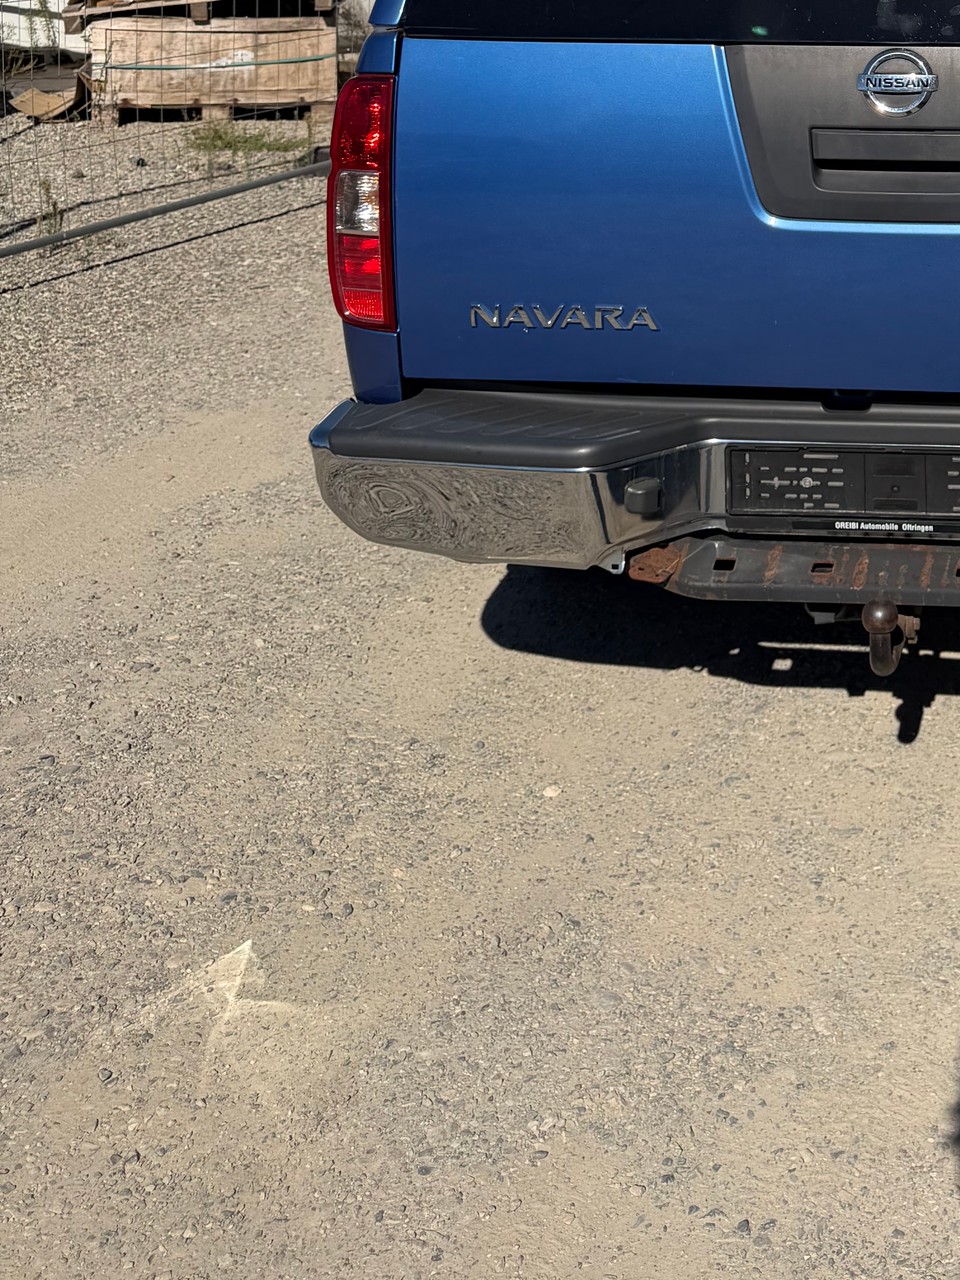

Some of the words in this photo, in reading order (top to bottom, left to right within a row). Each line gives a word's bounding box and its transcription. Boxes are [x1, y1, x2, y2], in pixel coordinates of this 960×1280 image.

[865, 77, 929, 88] NISSAN
[470, 303, 660, 331] NAVARA
[860, 522, 899, 531] Automobile
